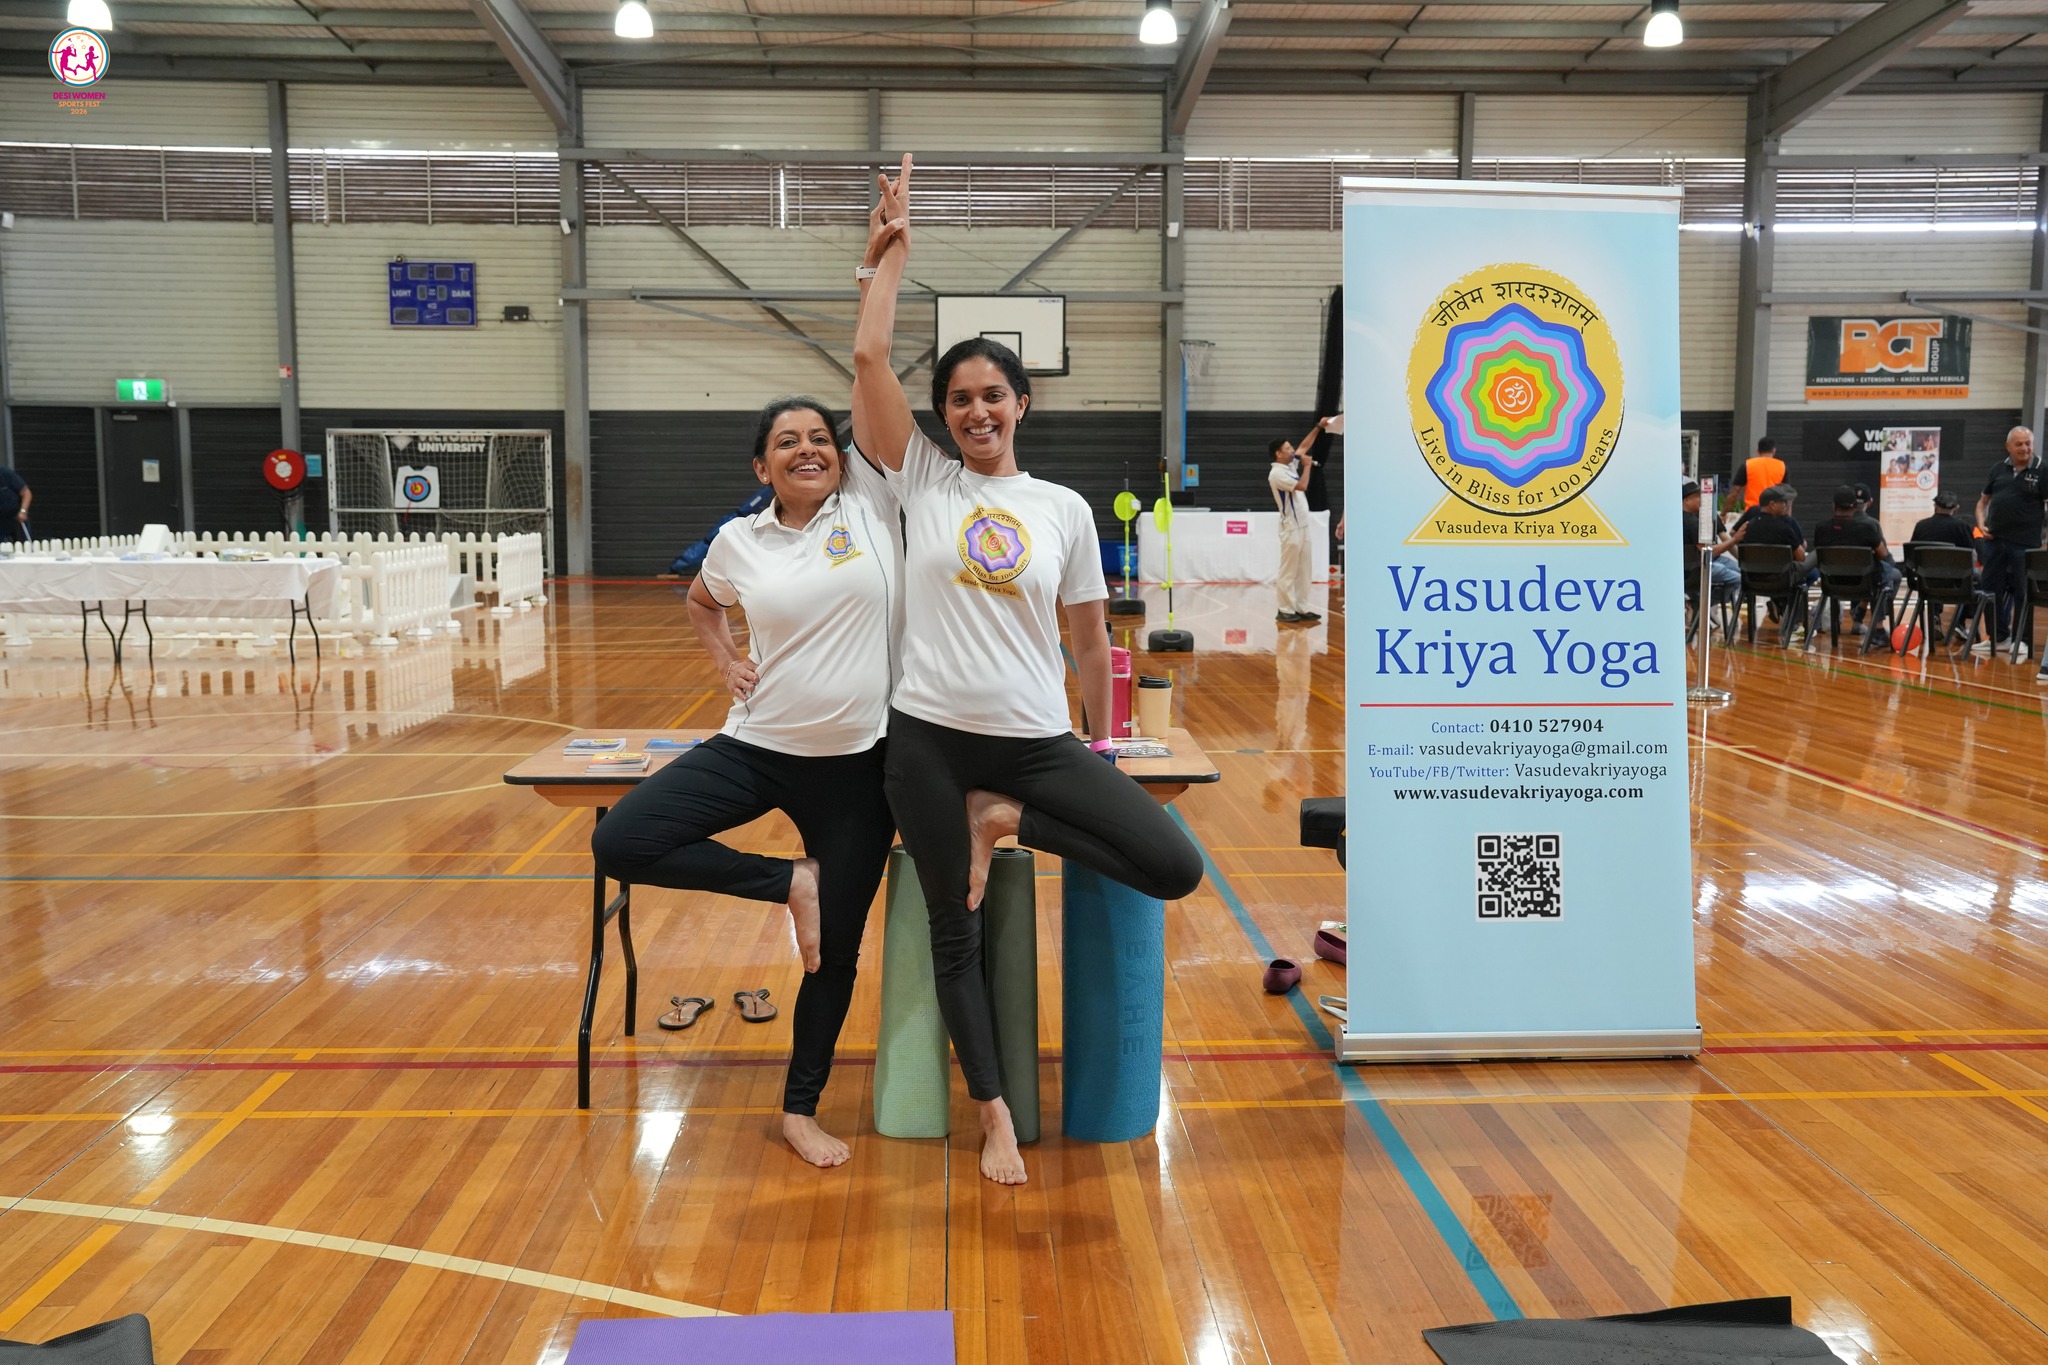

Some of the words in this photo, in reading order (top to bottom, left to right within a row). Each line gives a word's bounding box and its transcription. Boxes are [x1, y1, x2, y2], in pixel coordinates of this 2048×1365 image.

[452, 290, 471, 298] DARK
[1931, 341, 1940, 373] GROUP
[1811, 389, 1900, 397] www.bctgroup.com.au
[418, 442, 486, 453] UNIVERSITY
[1421, 427, 1446, 466] Live
[1446, 464, 1463, 486] in
[1467, 479, 1510, 505] Bliss
[1517, 490, 1543, 506] for
[1551, 474, 1581, 499] 100
[1581, 428, 1614, 478] years
[1435, 520, 1508, 535] Vasudeva
[1514, 521, 1555, 538] Kriya
[1560, 521, 1598, 538] Yoga
[972, 565, 987, 579] Bliss
[1387, 565, 1644, 612] Vasudeva
[1376, 628, 1517, 688] Kriya
[1533, 629, 1660, 688] Yoga
[1431, 721, 1484, 734] Contact:
[1489, 719, 1533, 734] 0410
[1538, 718, 1604, 733] 527904
[1368, 743, 1414, 756] E-mail:
[1418, 740, 1668, 758] vasudevakriyayoga@gmail.com
[1369, 765, 1509, 780] YouTube/FB/Twitter:
[1514, 763, 1667, 781] Vasudevakriyayoga
[1393, 784, 1644, 803] www.vasudevakriyayoga.com
[1123, 939, 1147, 1056] BAHE
